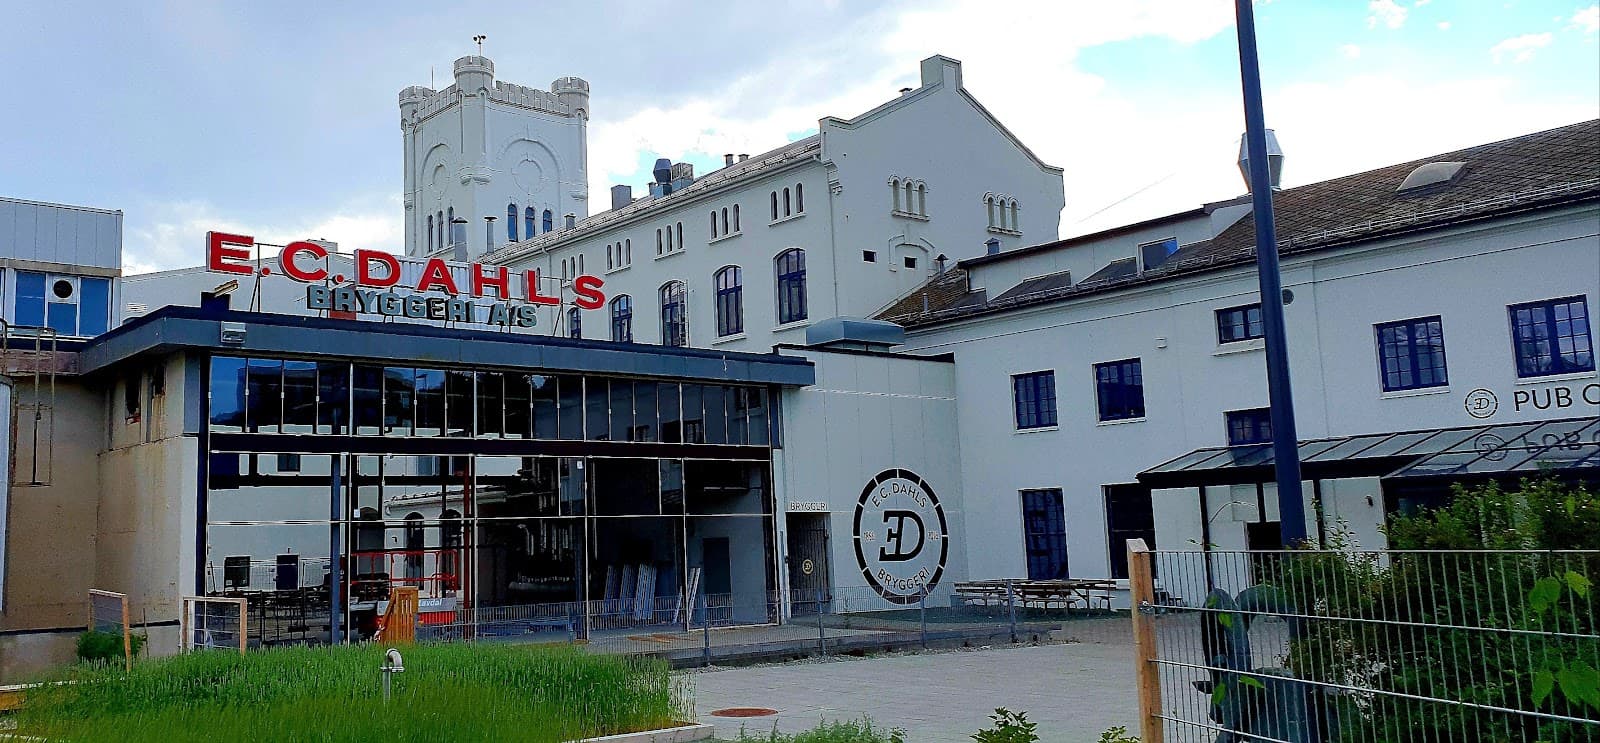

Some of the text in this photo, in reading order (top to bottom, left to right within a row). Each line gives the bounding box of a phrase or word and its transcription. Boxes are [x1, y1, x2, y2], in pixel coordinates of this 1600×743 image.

[307, 285, 476, 323] BRYGGERI
[1514, 387, 1573, 412] PUB
[790, 502, 828, 511] BRYGGERI
[877, 566, 930, 590] BRYGGERI
